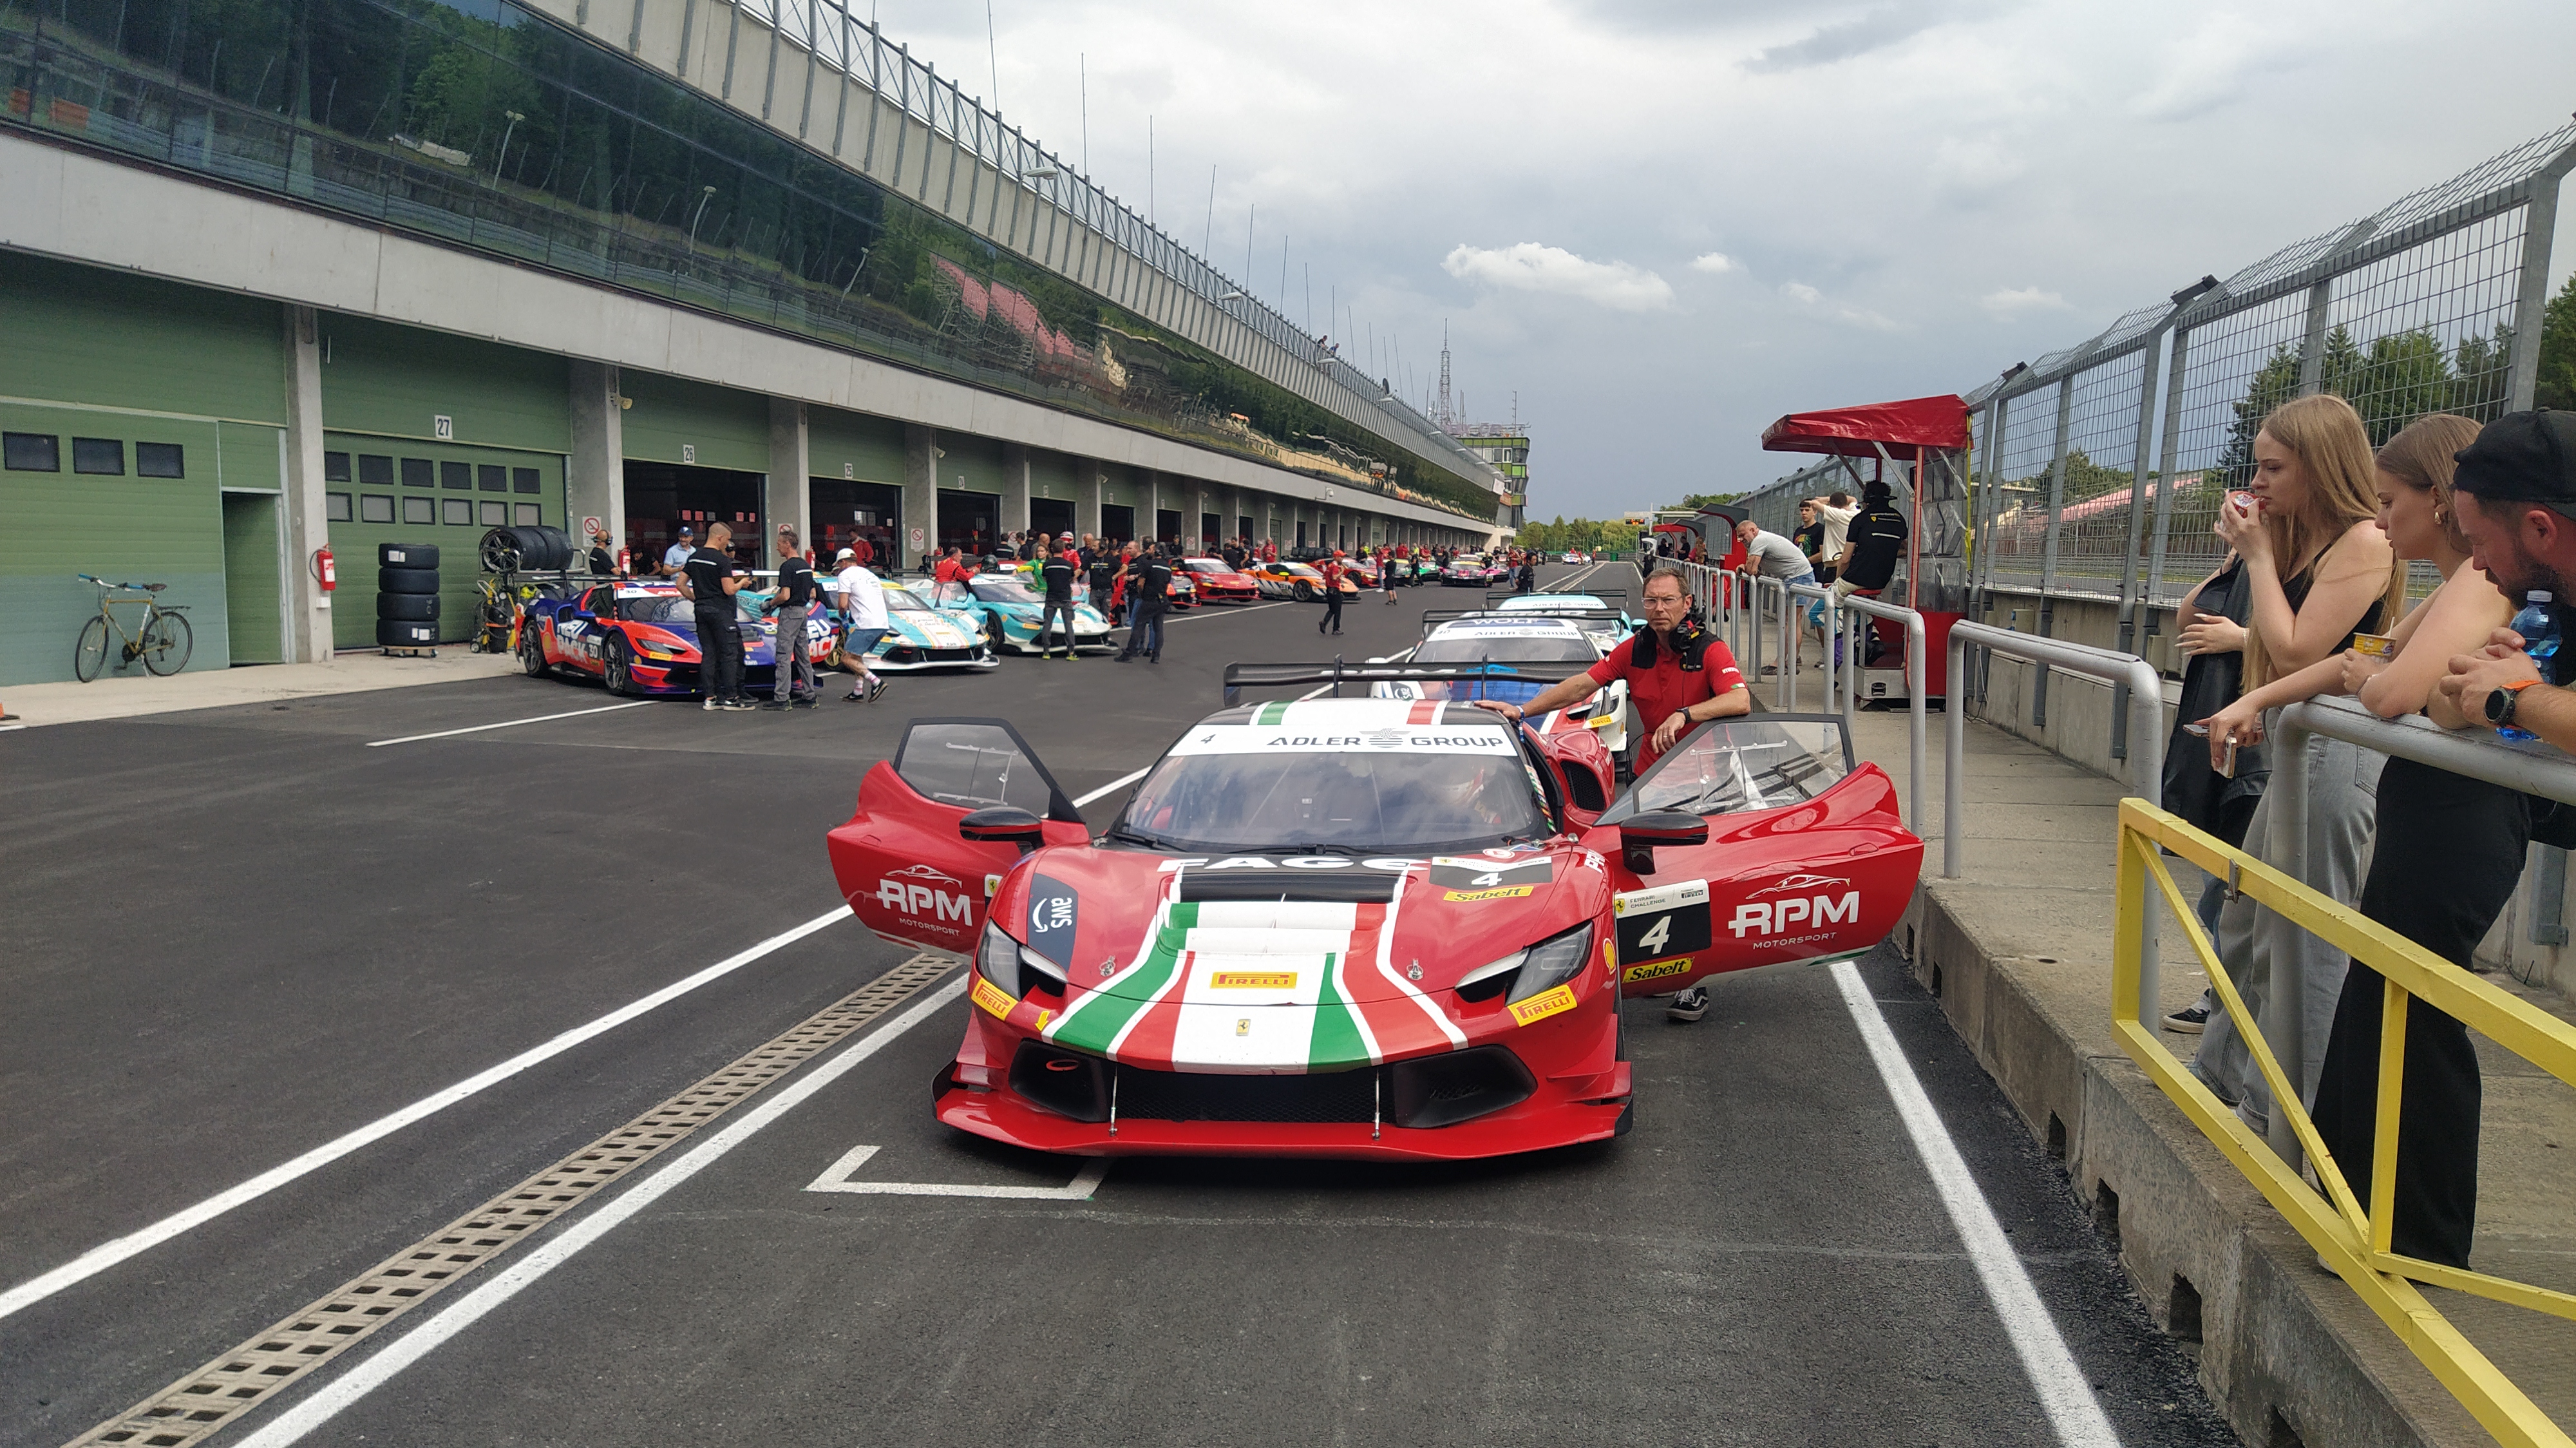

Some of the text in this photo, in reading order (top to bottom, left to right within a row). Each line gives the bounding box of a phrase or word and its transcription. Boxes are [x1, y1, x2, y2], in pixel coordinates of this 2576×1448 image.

[437, 418, 450, 436] 27
[685, 446, 693, 461] 26
[557, 620, 589, 640] NEU
[807, 619, 831, 638] EU
[557, 634, 589, 664] PACK
[589, 644, 598, 658] 30
[809, 634, 838, 658] ACK
[1200, 734, 1216, 744] 4
[1266, 737, 1503, 747] ADLER GROUP
[1472, 872, 1502, 886] 4
[876, 879, 973, 927] RPM
[1453, 888, 1524, 901] Sabelt
[1630, 895, 1655, 904] FERRARI
[1681, 889, 1704, 899] PIRELLI
[1050, 897, 1072, 928] aws
[1630, 899, 1666, 909] CHALLENGE
[1728, 891, 1860, 938] RPM
[899, 917, 960, 937] MOTORSPORT
[1638, 915, 1672, 955] 4
[1752, 932, 1837, 950] MOTORSPORT
[1629, 959, 1687, 980] Sabelt
[1218, 974, 1290, 985] PIRELLI
[976, 984, 1010, 1014] PIRELLI
[1516, 990, 1571, 1020] PIRELLI
